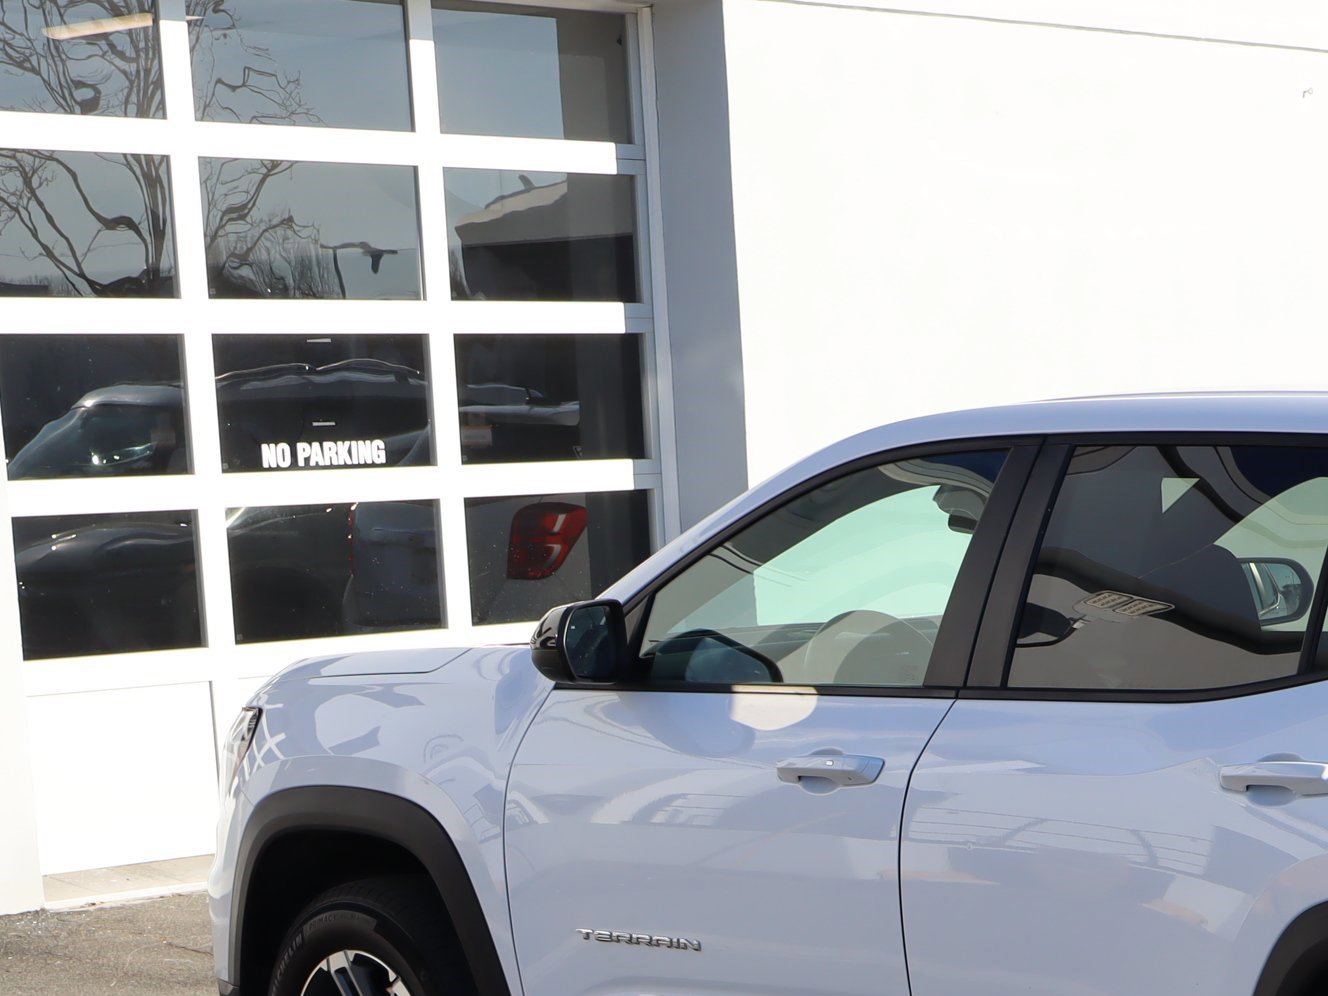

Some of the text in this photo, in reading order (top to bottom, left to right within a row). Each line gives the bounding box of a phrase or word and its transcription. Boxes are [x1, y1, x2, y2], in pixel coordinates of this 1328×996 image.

[261, 439, 386, 468] NO PARKING
[575, 928, 702, 952] TERRAIN
